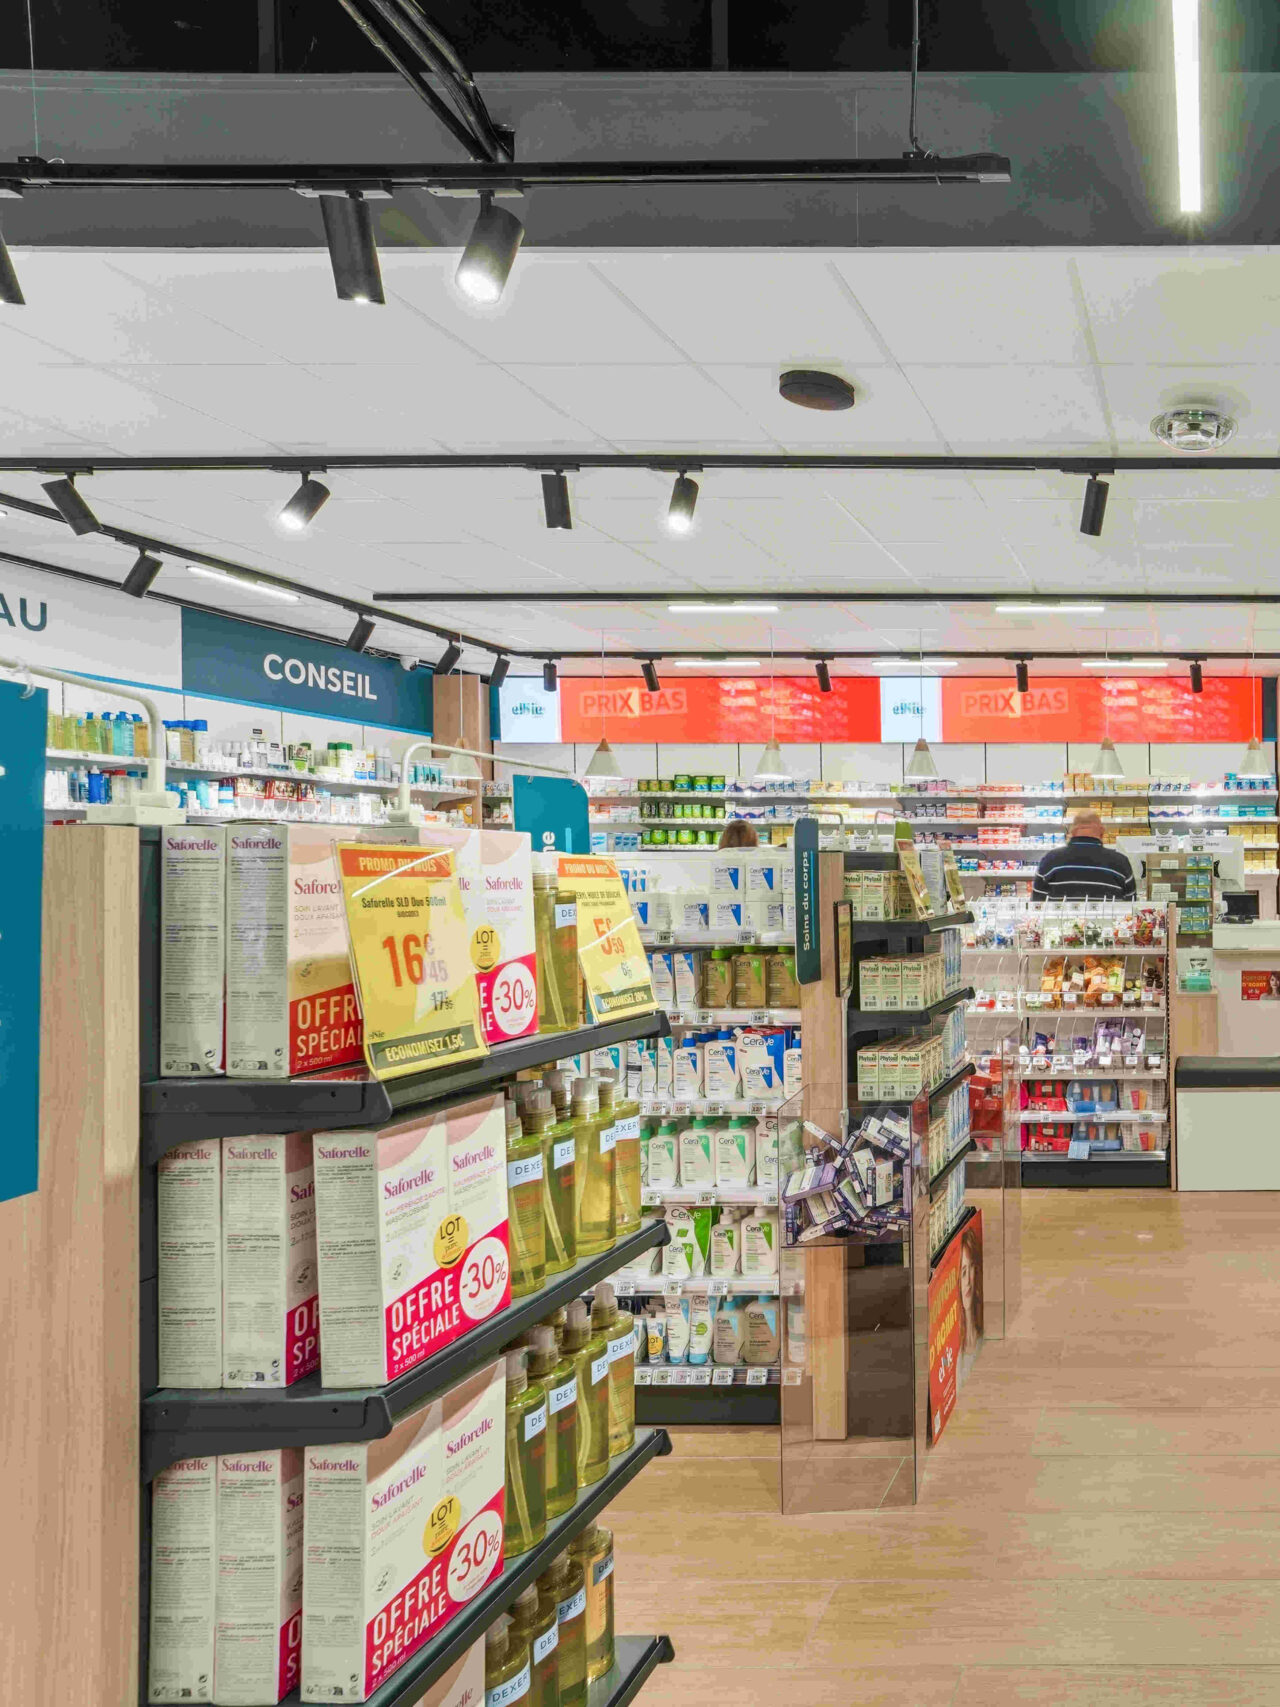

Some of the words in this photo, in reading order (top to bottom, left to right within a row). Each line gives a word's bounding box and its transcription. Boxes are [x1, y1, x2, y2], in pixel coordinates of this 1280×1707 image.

[263, 653, 378, 700] CONSEIL
[584, 692, 634, 716] PRIX
[640, 690, 685, 713] BAS
[964, 692, 1016, 715] PRIX
[1022, 690, 1066, 712] BAS
[166, 837, 217, 851] Saforelle
[231, 836, 282, 850] Saforelle
[359, 856, 396, 872] PROMO
[413, 858, 437, 872] MOIS
[802, 851, 811, 890] corps
[485, 876, 523, 891] Saforelle
[361, 897, 395, 909] Saforelle
[396, 897, 410, 908] SLD
[411, 898, 425, 908] Duo
[425, 896, 447, 907] 500ml
[803, 895, 810, 910] du
[476, 930, 494, 944] LOT
[803, 920, 811, 951] Soins
[495, 979, 534, 1013] -30%
[385, 1040, 444, 1063] ECONOMISEZ
[742, 1036, 775, 1047] CeraVe
[227, 1146, 278, 1160] Saforelle
[318, 1145, 370, 1160] Saforelle
[452, 1144, 495, 1172] Saforelle
[384, 1168, 435, 1200] Saforelle
[439, 1216, 462, 1241] LOT
[462, 1254, 507, 1299] -30%
[391, 1274, 455, 1333] OFFRE
[392, 1302, 461, 1361] SPÉCIALE
[446, 1416, 494, 1459] Saforelle
[221, 1459, 273, 1473] Saforelle
[309, 1457, 360, 1472] Saforelle
[371, 1463, 427, 1512] Saforelle
[430, 1499, 454, 1527] LOT
[451, 1529, 500, 1582] -30%
[373, 1563, 443, 1645] OFFRE
[372, 1593, 447, 1676] SPÉCIALE
